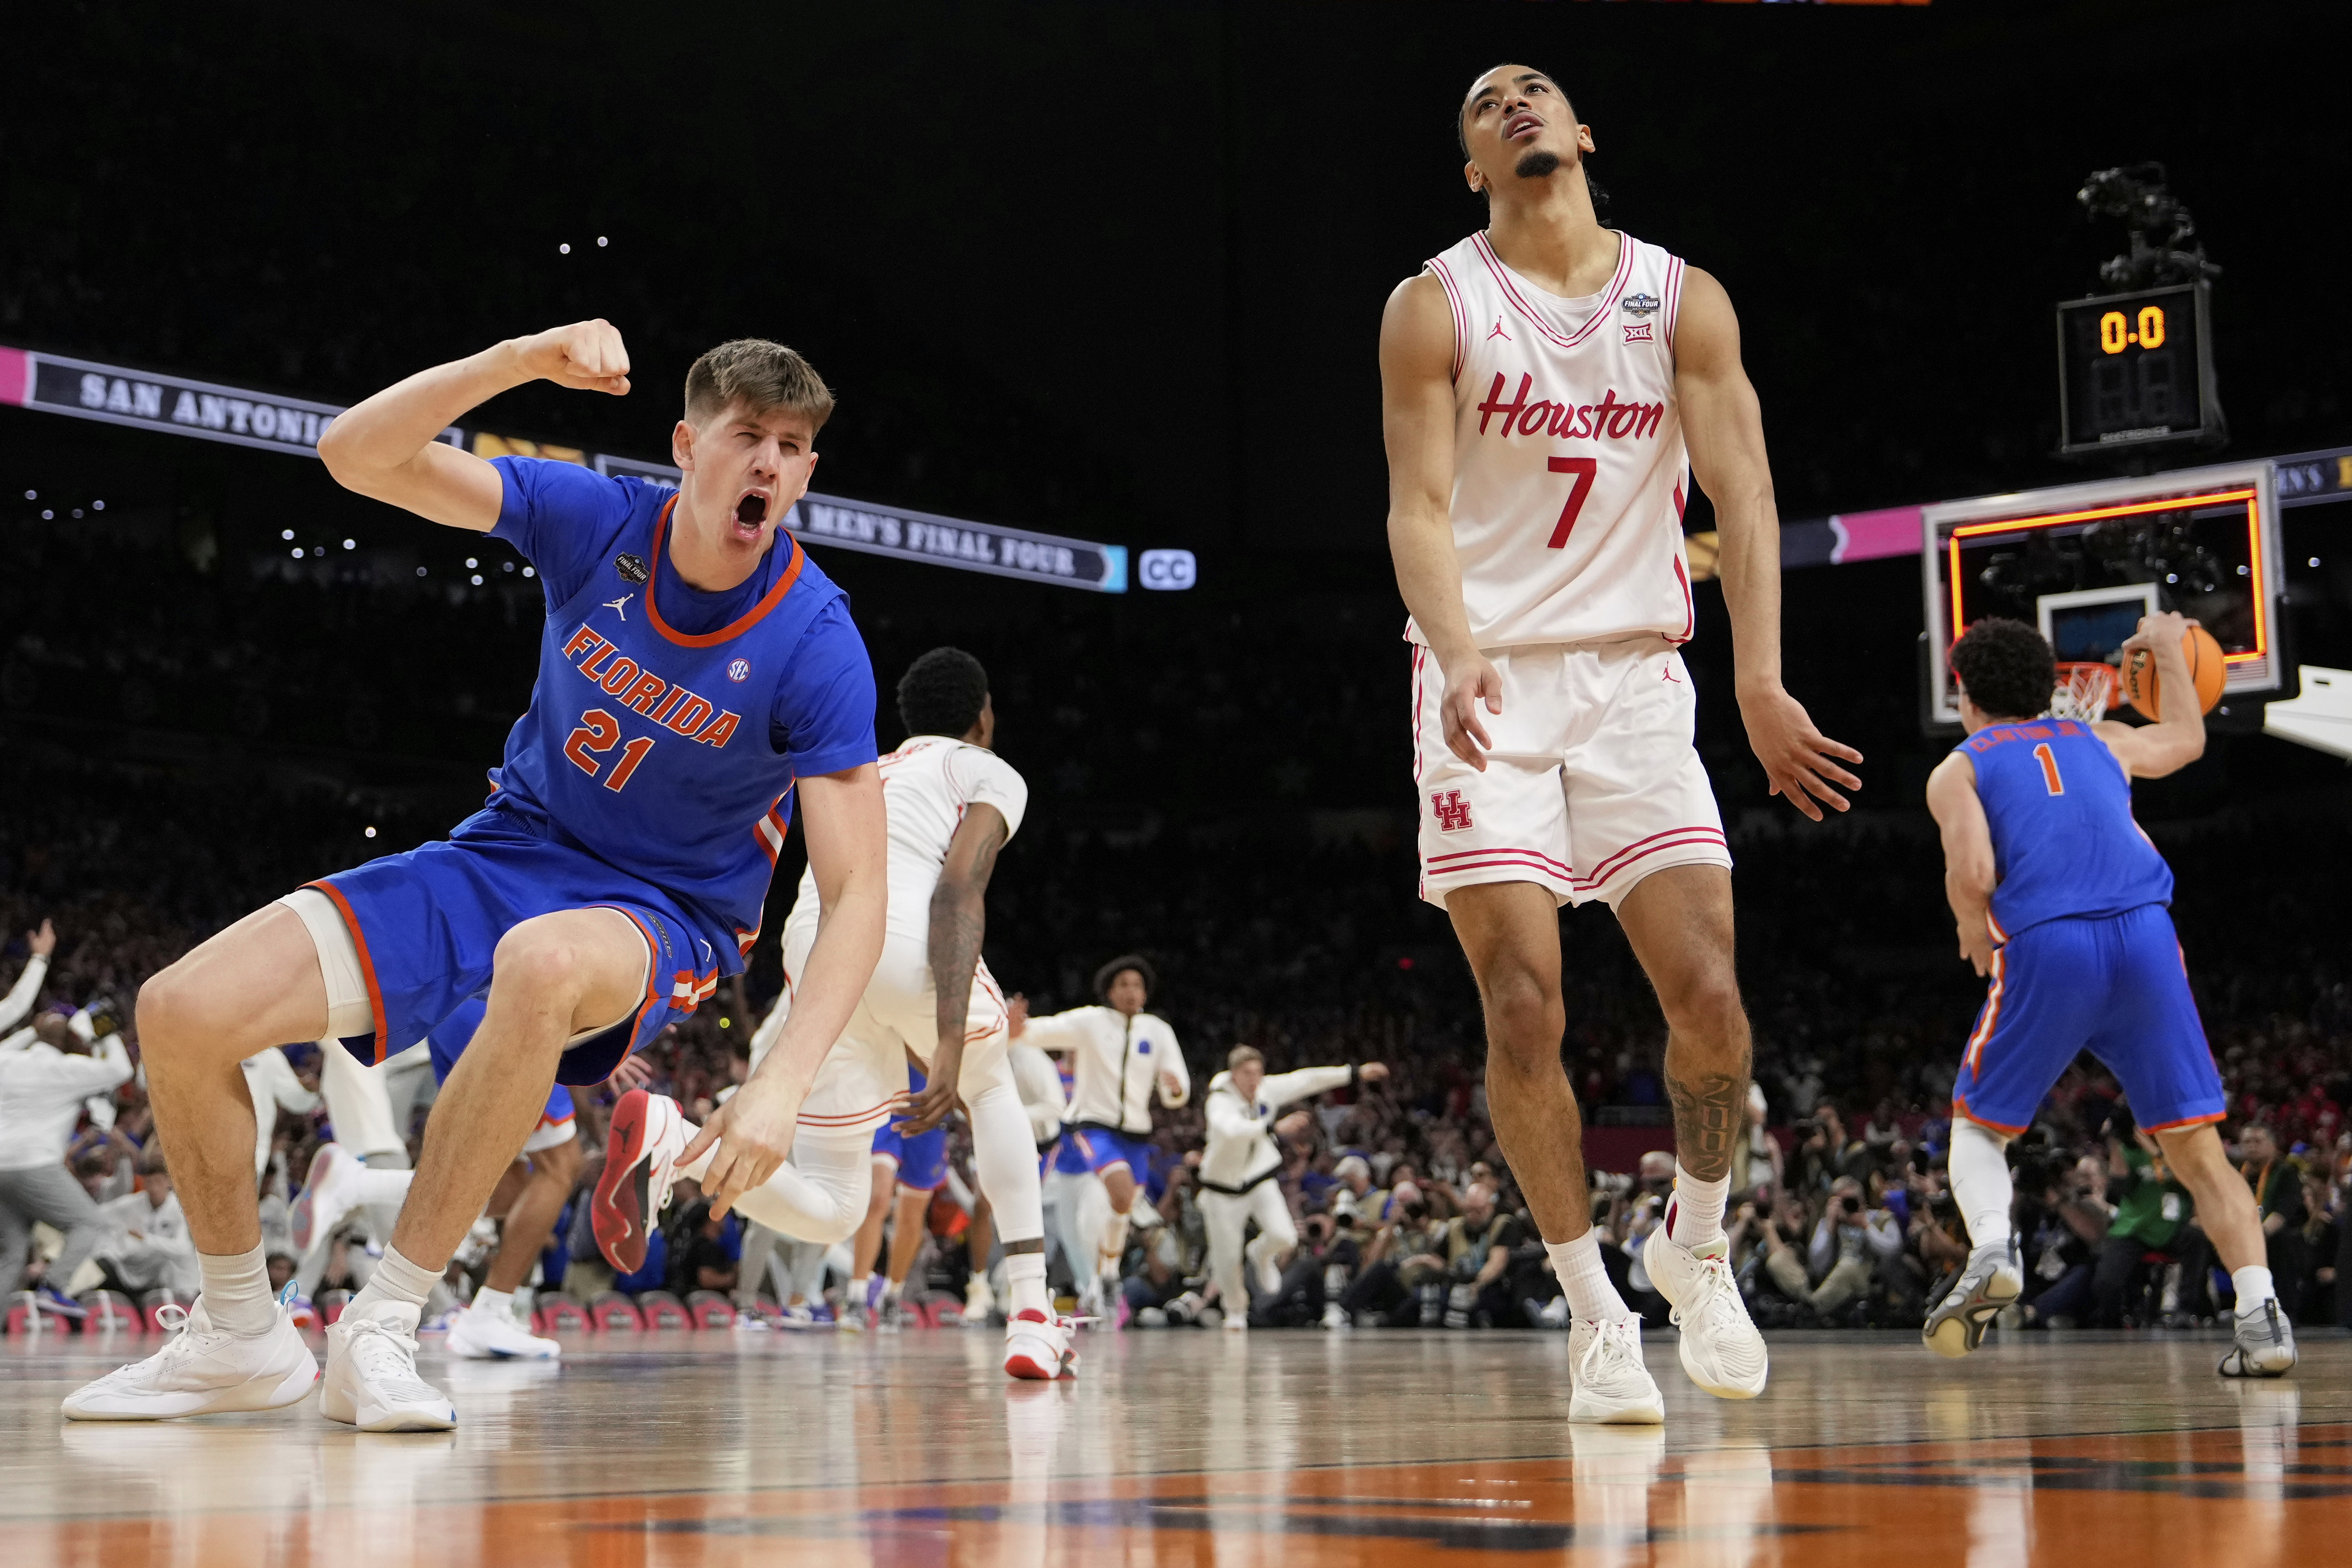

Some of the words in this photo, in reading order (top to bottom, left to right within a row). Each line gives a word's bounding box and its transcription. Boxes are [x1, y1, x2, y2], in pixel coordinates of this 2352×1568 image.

[2100, 306, 2165, 354] 0.0
[80, 373, 163, 418] SAN
[1477, 372, 1664, 441] Houston
[1547, 456, 1597, 549] 7
[808, 503, 902, 547] MEN'S
[907, 521, 996, 564] FINAL
[1000, 537, 1076, 576] FOUR
[617, 556, 633, 570] FINAL
[631, 567, 647, 580] FOUR
[1148, 558, 1186, 580] CC
[561, 622, 741, 748] FLORIDA
[729, 660, 748, 681] SEC
[563, 708, 655, 793] 21
[2033, 742, 2065, 797] 1
